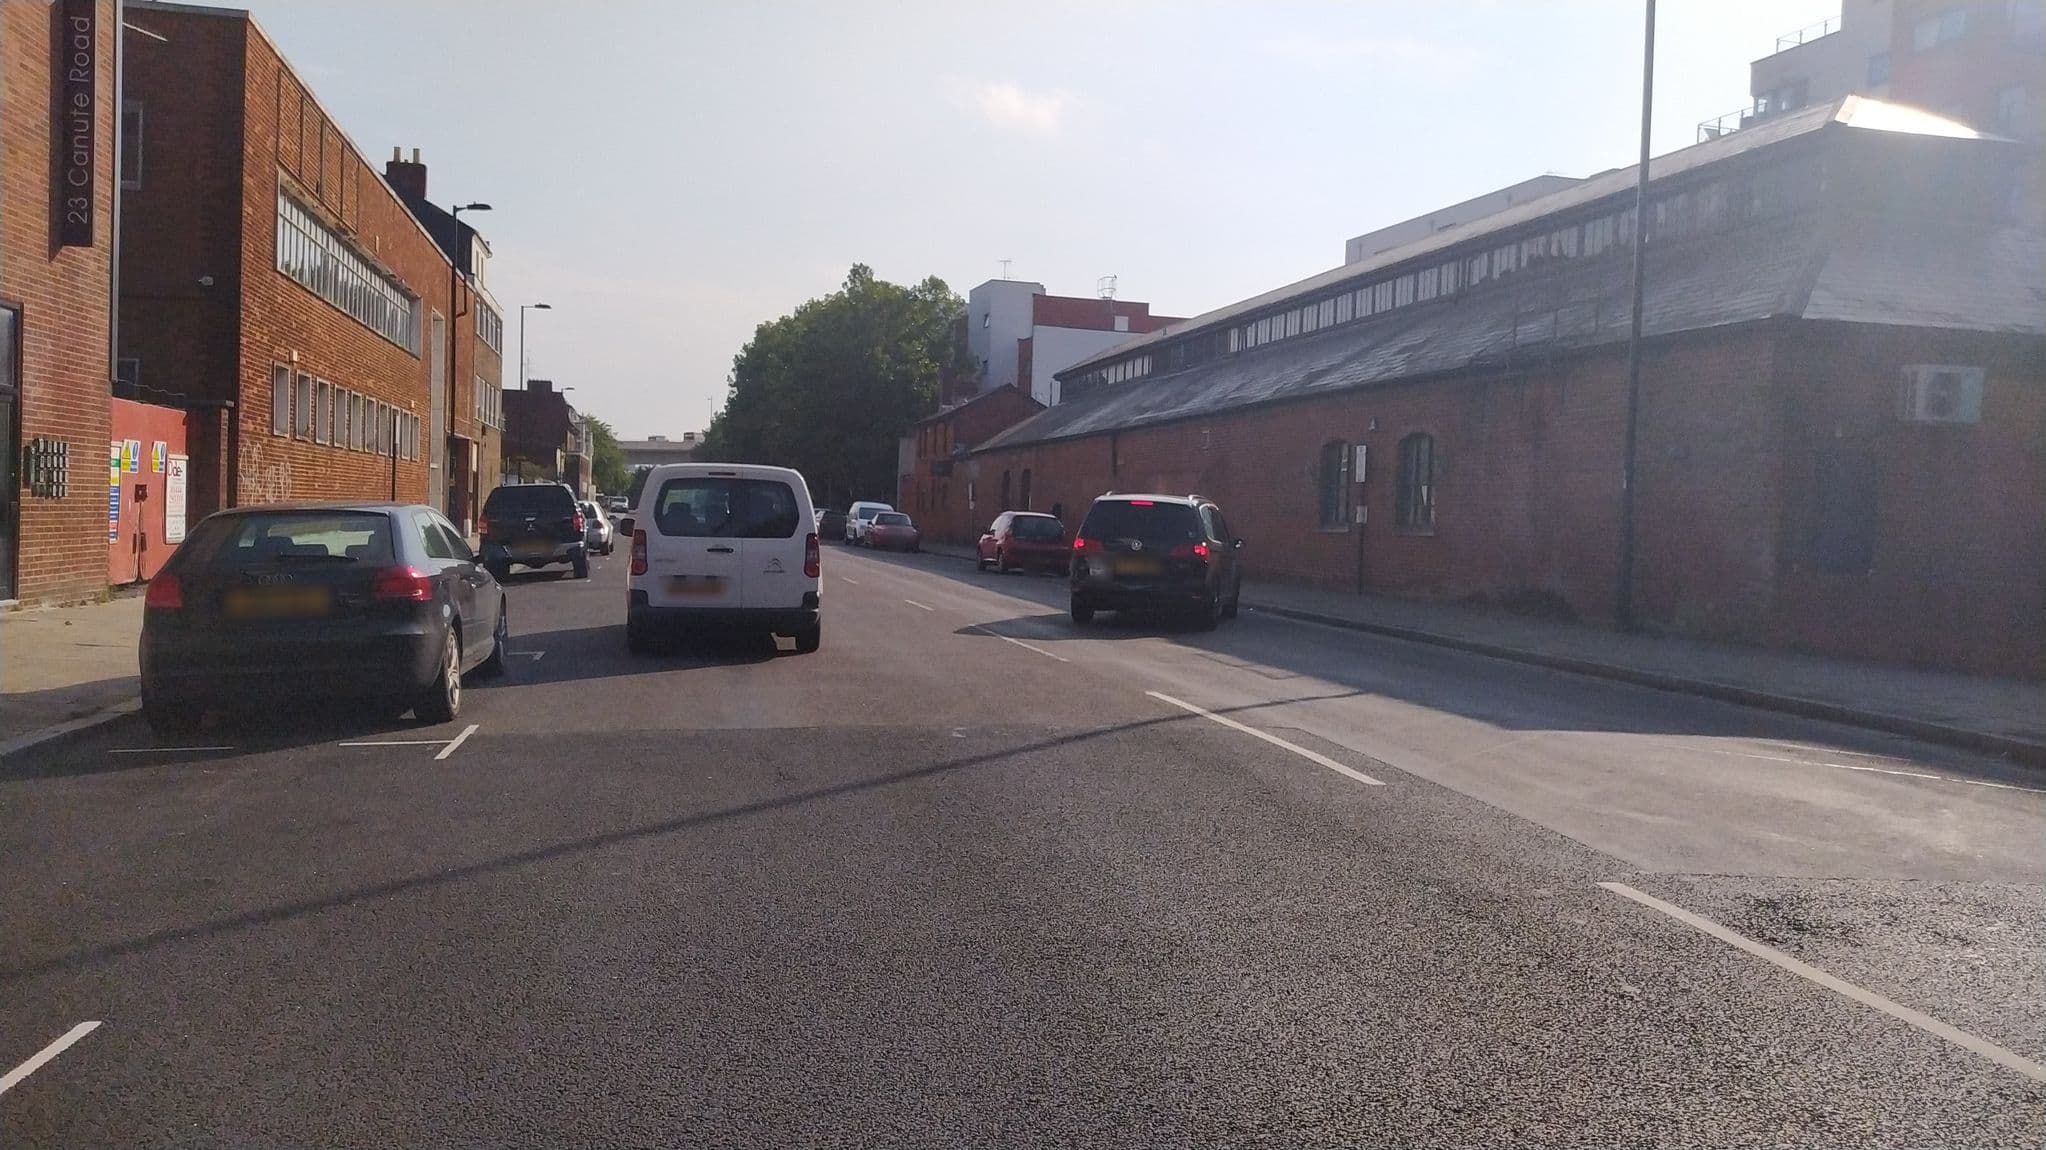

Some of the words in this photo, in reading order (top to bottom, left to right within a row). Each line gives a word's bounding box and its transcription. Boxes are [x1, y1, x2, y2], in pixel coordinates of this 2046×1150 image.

[69, 16, 90, 82] Road
[68, 92, 90, 187] Canute
[67, 197, 88, 224] 23
